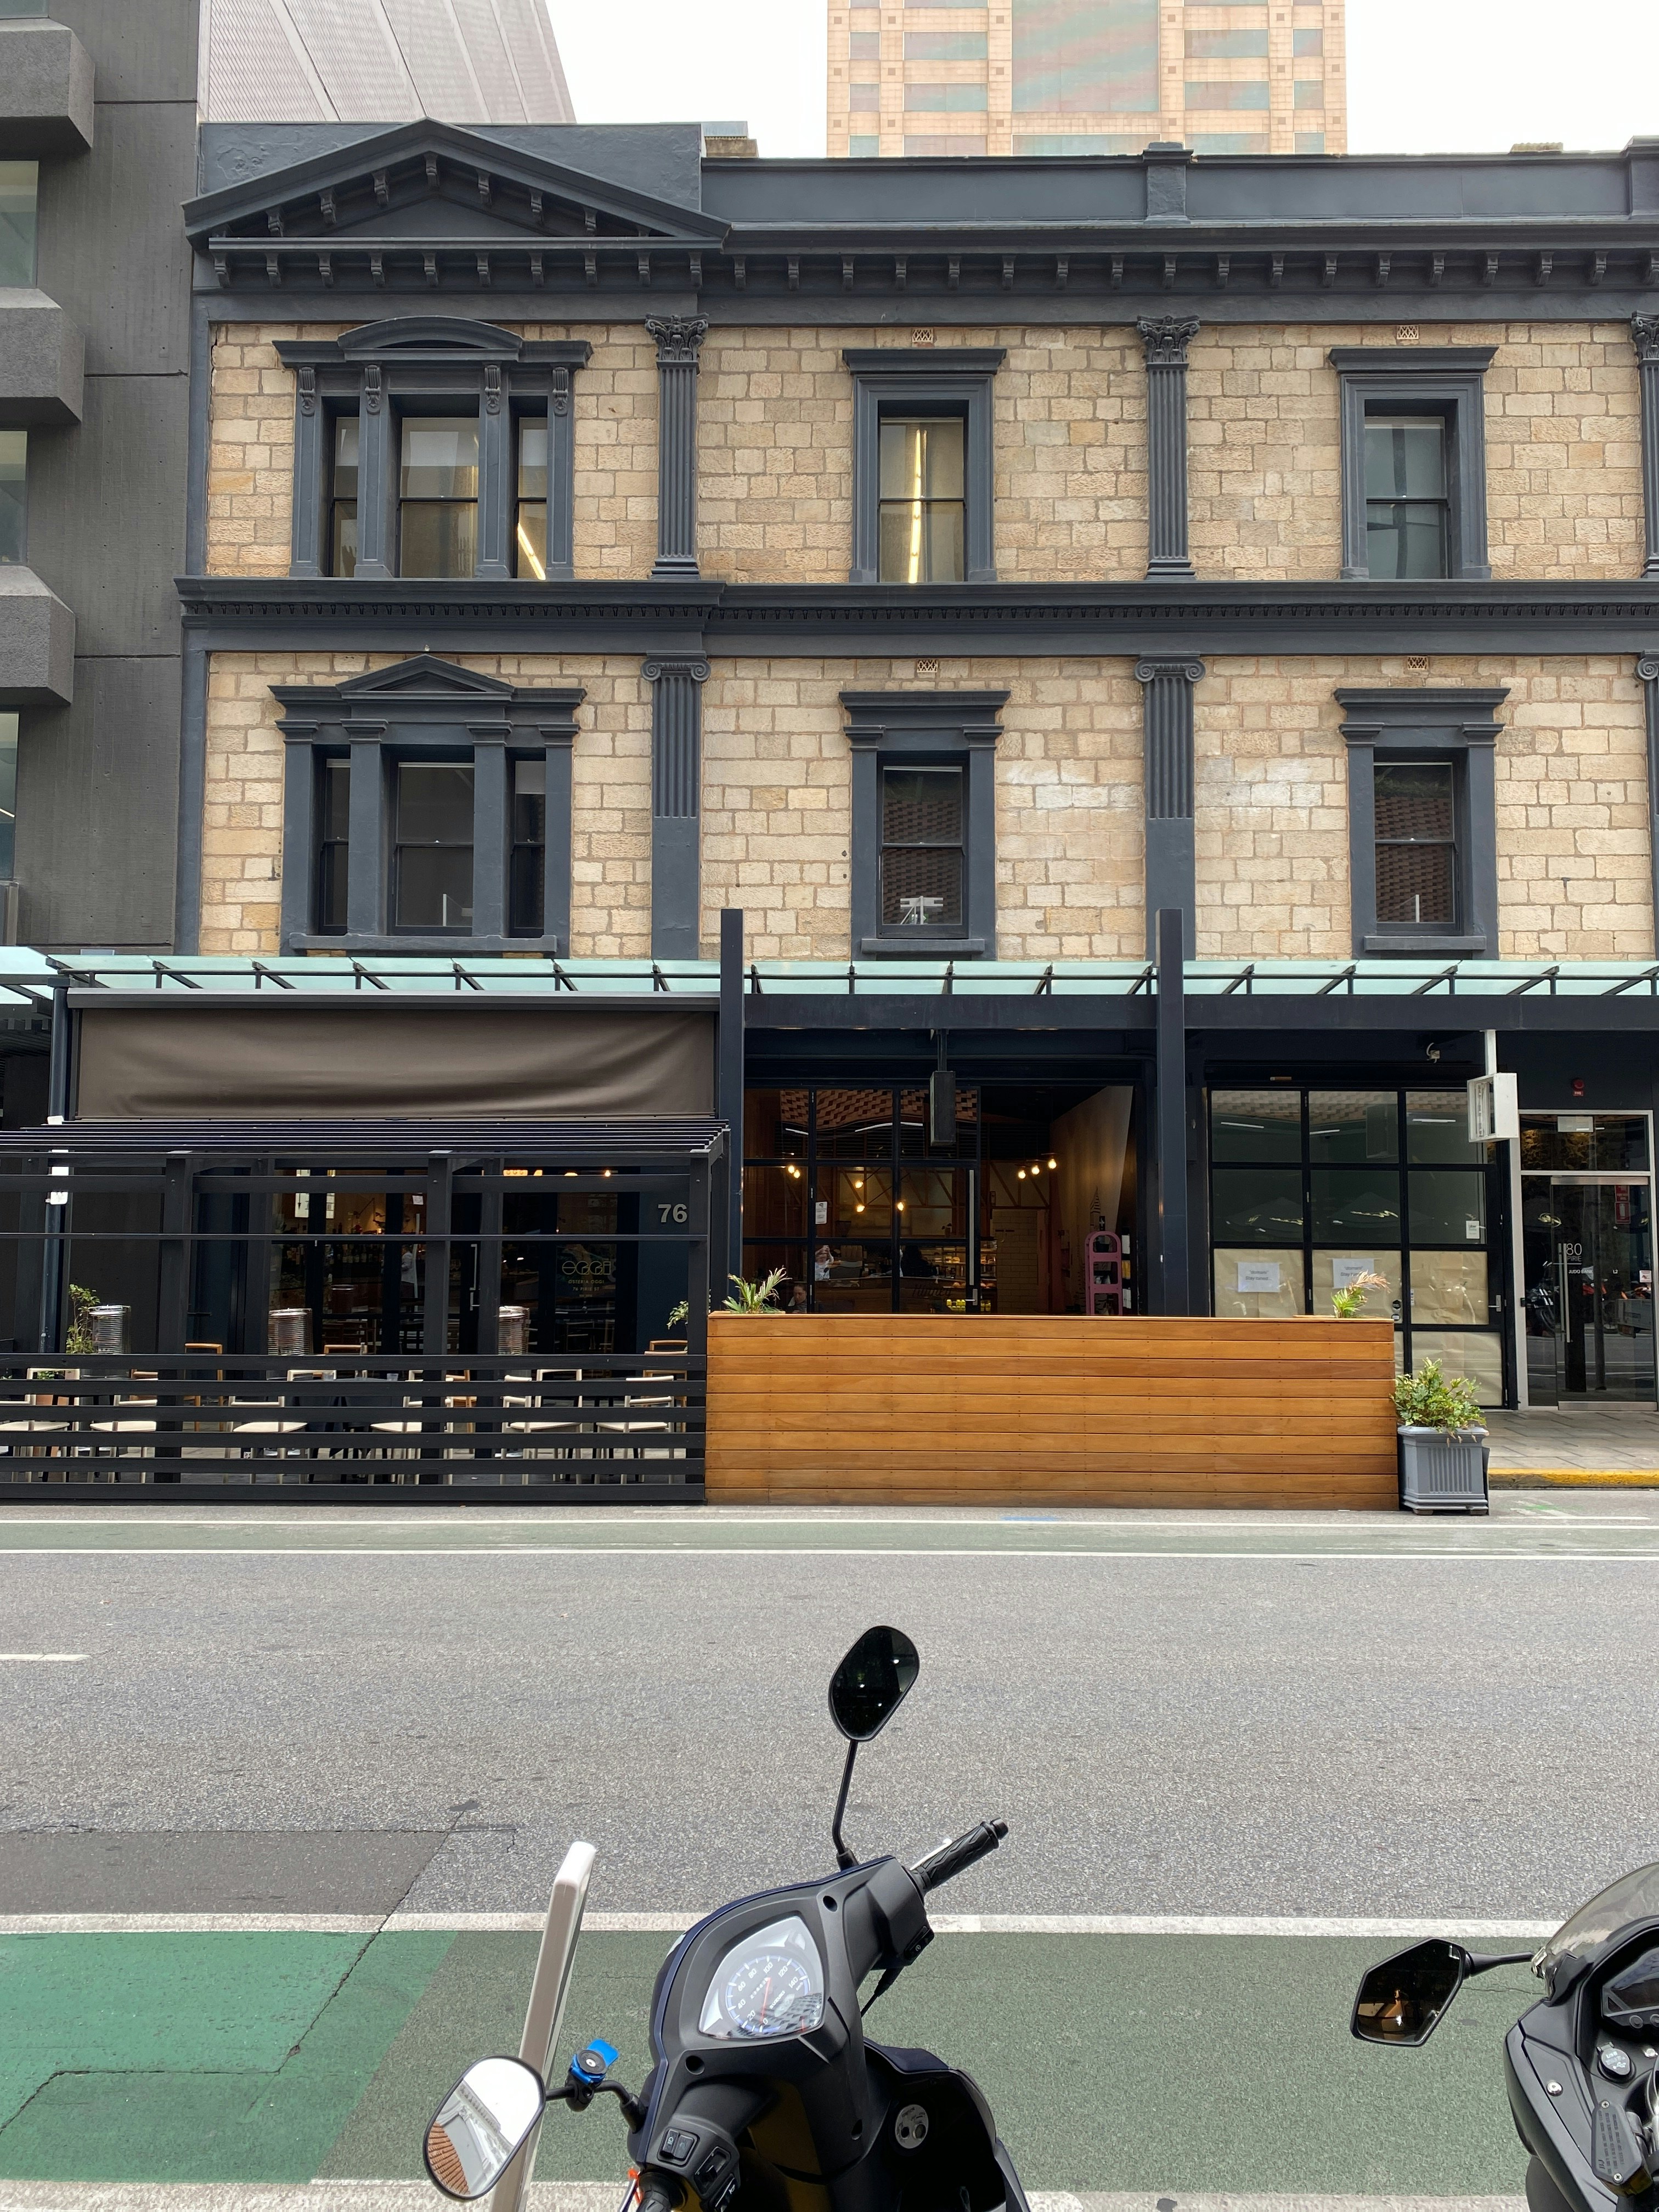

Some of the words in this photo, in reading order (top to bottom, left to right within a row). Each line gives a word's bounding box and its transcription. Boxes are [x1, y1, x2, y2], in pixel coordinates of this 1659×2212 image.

[658, 1203, 688, 1223] 76
[1566, 1243, 1583, 1255] 80
[763, 1962, 773, 1973] 100
[778, 1966, 788, 1977] 120
[748, 1968, 757, 1979] 80
[738, 1981, 746, 1991] 60
[788, 1976, 798, 1989] 140
[737, 1999, 746, 2009] 40
[769, 1990, 786, 2009] SUZUKI
[747, 2010, 756, 2021] 20
